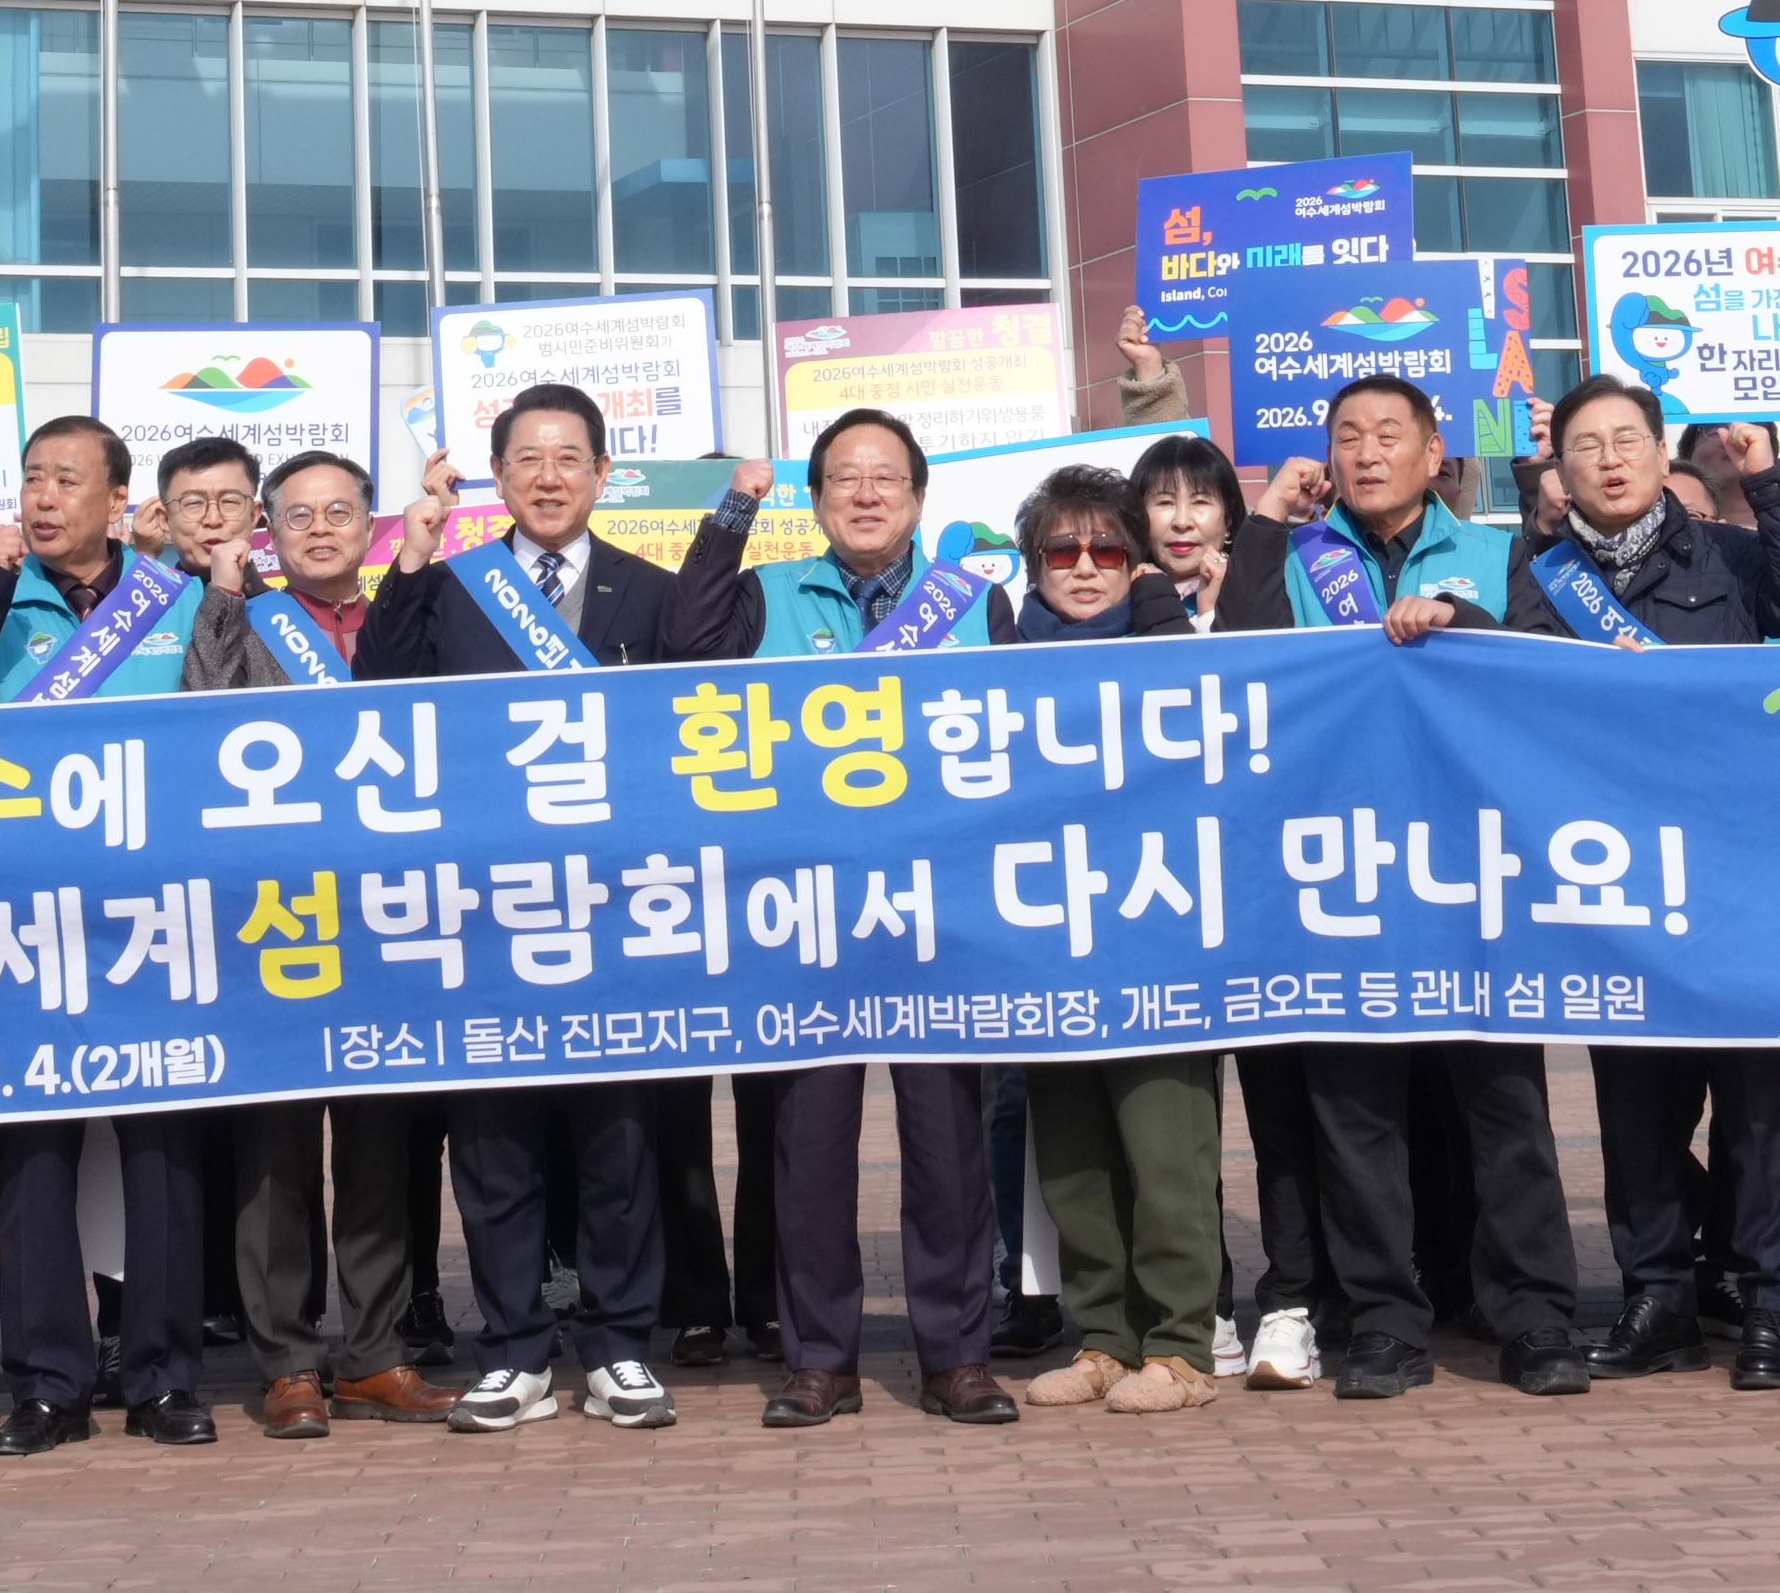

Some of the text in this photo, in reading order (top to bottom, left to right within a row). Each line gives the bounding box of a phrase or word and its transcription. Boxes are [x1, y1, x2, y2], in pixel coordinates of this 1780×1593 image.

[1295, 199, 1385, 218] 여수세계섬박람회
[1296, 196, 1322, 207] 2026
[1164, 205, 1212, 246] 섬,
[1161, 234, 1389, 280] 바다와 미래를 잇다
[1621, 248, 1733, 279] 2026년
[1161, 287, 1205, 303] Island,
[1693, 282, 1745, 312] 섬을
[523, 313, 686, 339] 2026여수세계섬박람회
[929, 312, 1053, 350] 깔끔한 청결
[1255, 332, 1313, 354] 2026
[471, 359, 681, 389] 2026여수세계섬박람회
[813, 353, 1027, 383] 2026여수세계섬박람회 성공개최
[1254, 348, 1452, 382] 여수세계섬박람회
[839, 375, 1003, 401] 4대 중점 시민 실천운동
[121, 423, 349, 447] 2026여수세계섬박람회
[132, 569, 169, 606] 2026
[924, 580, 956, 621] 2026
[1322, 569, 1359, 604] 2026
[1571, 572, 1602, 613] 2026
[201, 702, 442, 833] 오신
[506, 692, 611, 823] 걸
[671, 674, 1270, 812] 환영합니다!
[993, 816, 1223, 958] 다시
[1282, 808, 1690, 940] 만나요!
[464, 1014, 547, 1065] 돌산
[561, 1007, 743, 1060] 진모지구,
[757, 988, 1109, 1049] 여수세계박람회장,
[1122, 982, 1212, 1036] 개도,
[1223, 972, 1346, 1023] 금오도
[1357, 972, 1399, 1021] 등
[1411, 968, 1490, 1020] 관내
[1504, 971, 1546, 1020] 섬
[1560, 973, 1645, 1022] 일원
